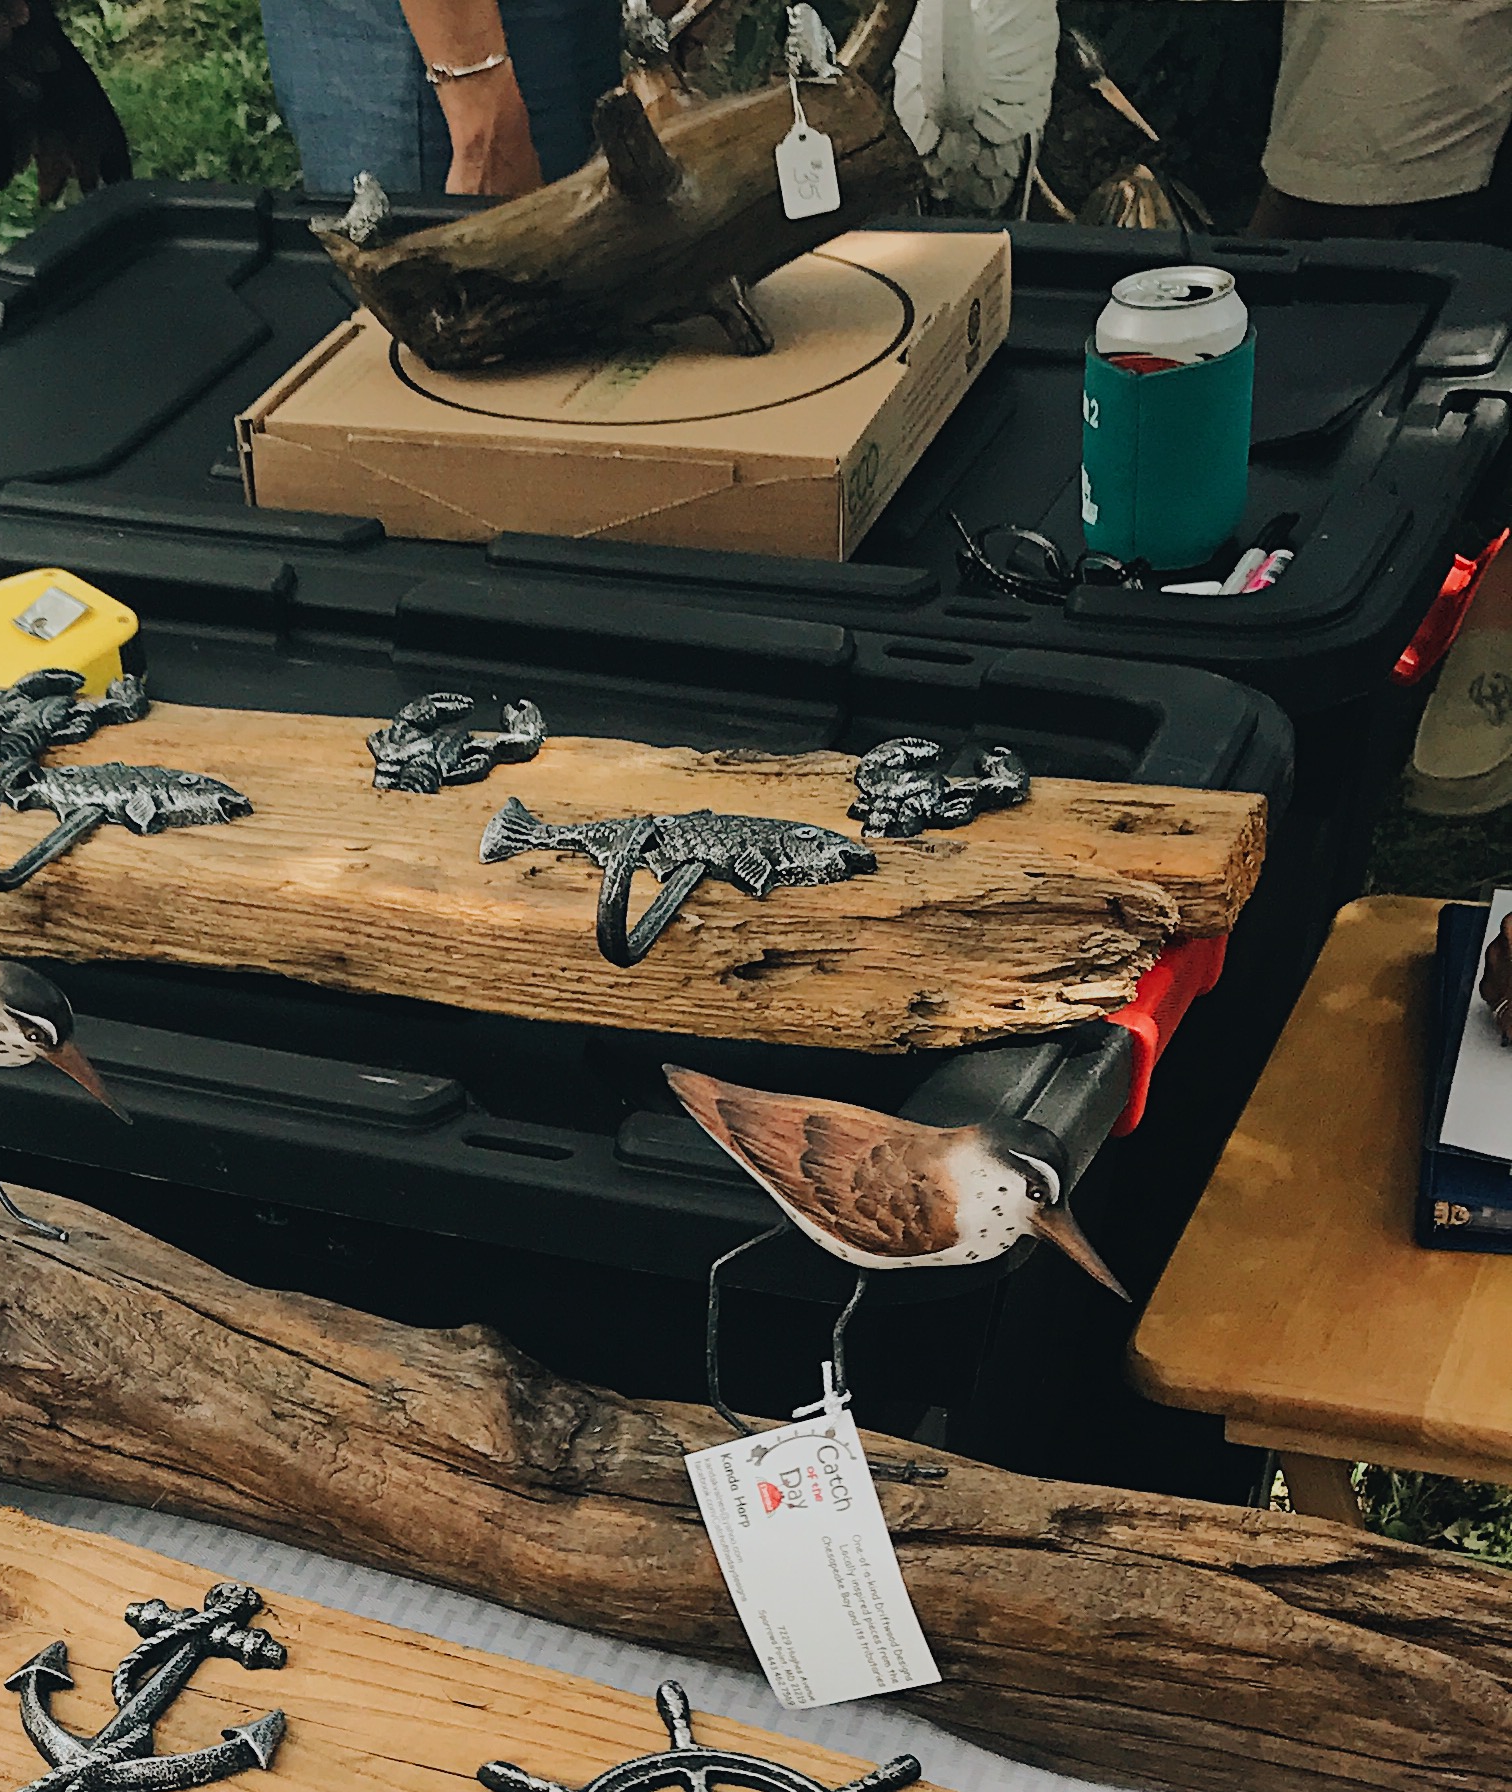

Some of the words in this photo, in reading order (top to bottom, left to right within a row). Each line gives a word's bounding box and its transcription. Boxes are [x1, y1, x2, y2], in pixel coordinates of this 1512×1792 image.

[721, 1453, 739, 1491] Kanda
[734, 1496, 750, 1527] Harp
[779, 1468, 808, 1509] Day
[807, 1466, 818, 1479] of
[812, 1482, 823, 1502] the
[817, 1445, 852, 1511] Catch
[822, 1536, 845, 1590] Chesapeake
[841, 1592, 852, 1607] Bay
[848, 1611, 861, 1626] and
[855, 1629, 865, 1640] its
[861, 1643, 886, 1687] tributaries
[839, 1544, 856, 1576] Locally
[852, 1580, 872, 1615] inspired
[863, 1617, 882, 1644] pieces
[877, 1647, 891, 1667] from
[889, 1669, 899, 1683] the
[875, 1603, 900, 1647] Driftwood
[893, 1649, 913, 1681] Designs
